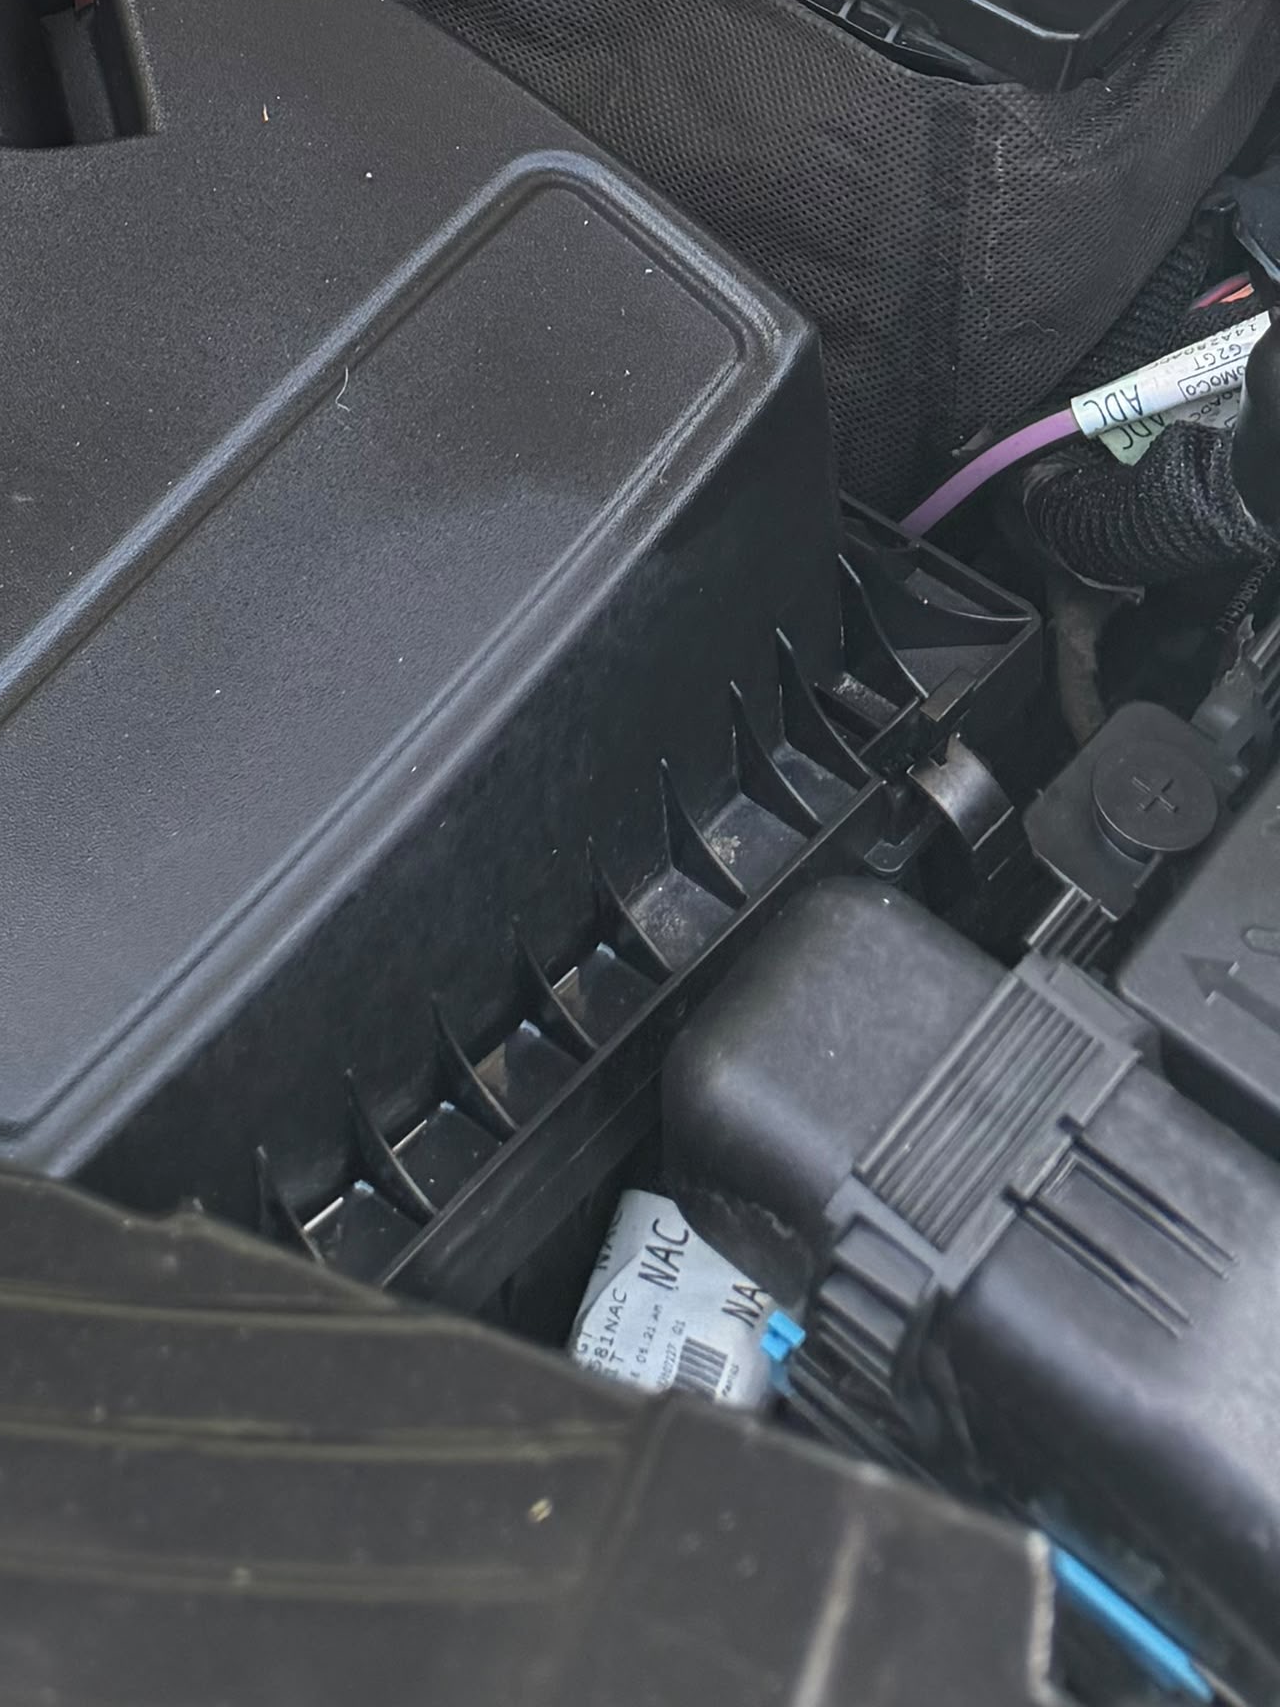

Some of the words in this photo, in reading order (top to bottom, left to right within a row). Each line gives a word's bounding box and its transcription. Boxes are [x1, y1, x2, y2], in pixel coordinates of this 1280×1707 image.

[1194, 343, 1242, 370] G2GT
[1083, 384, 1143, 428] ADC
[638, 1218, 690, 1291] NAC
[720, 1282, 770, 1330] NA
